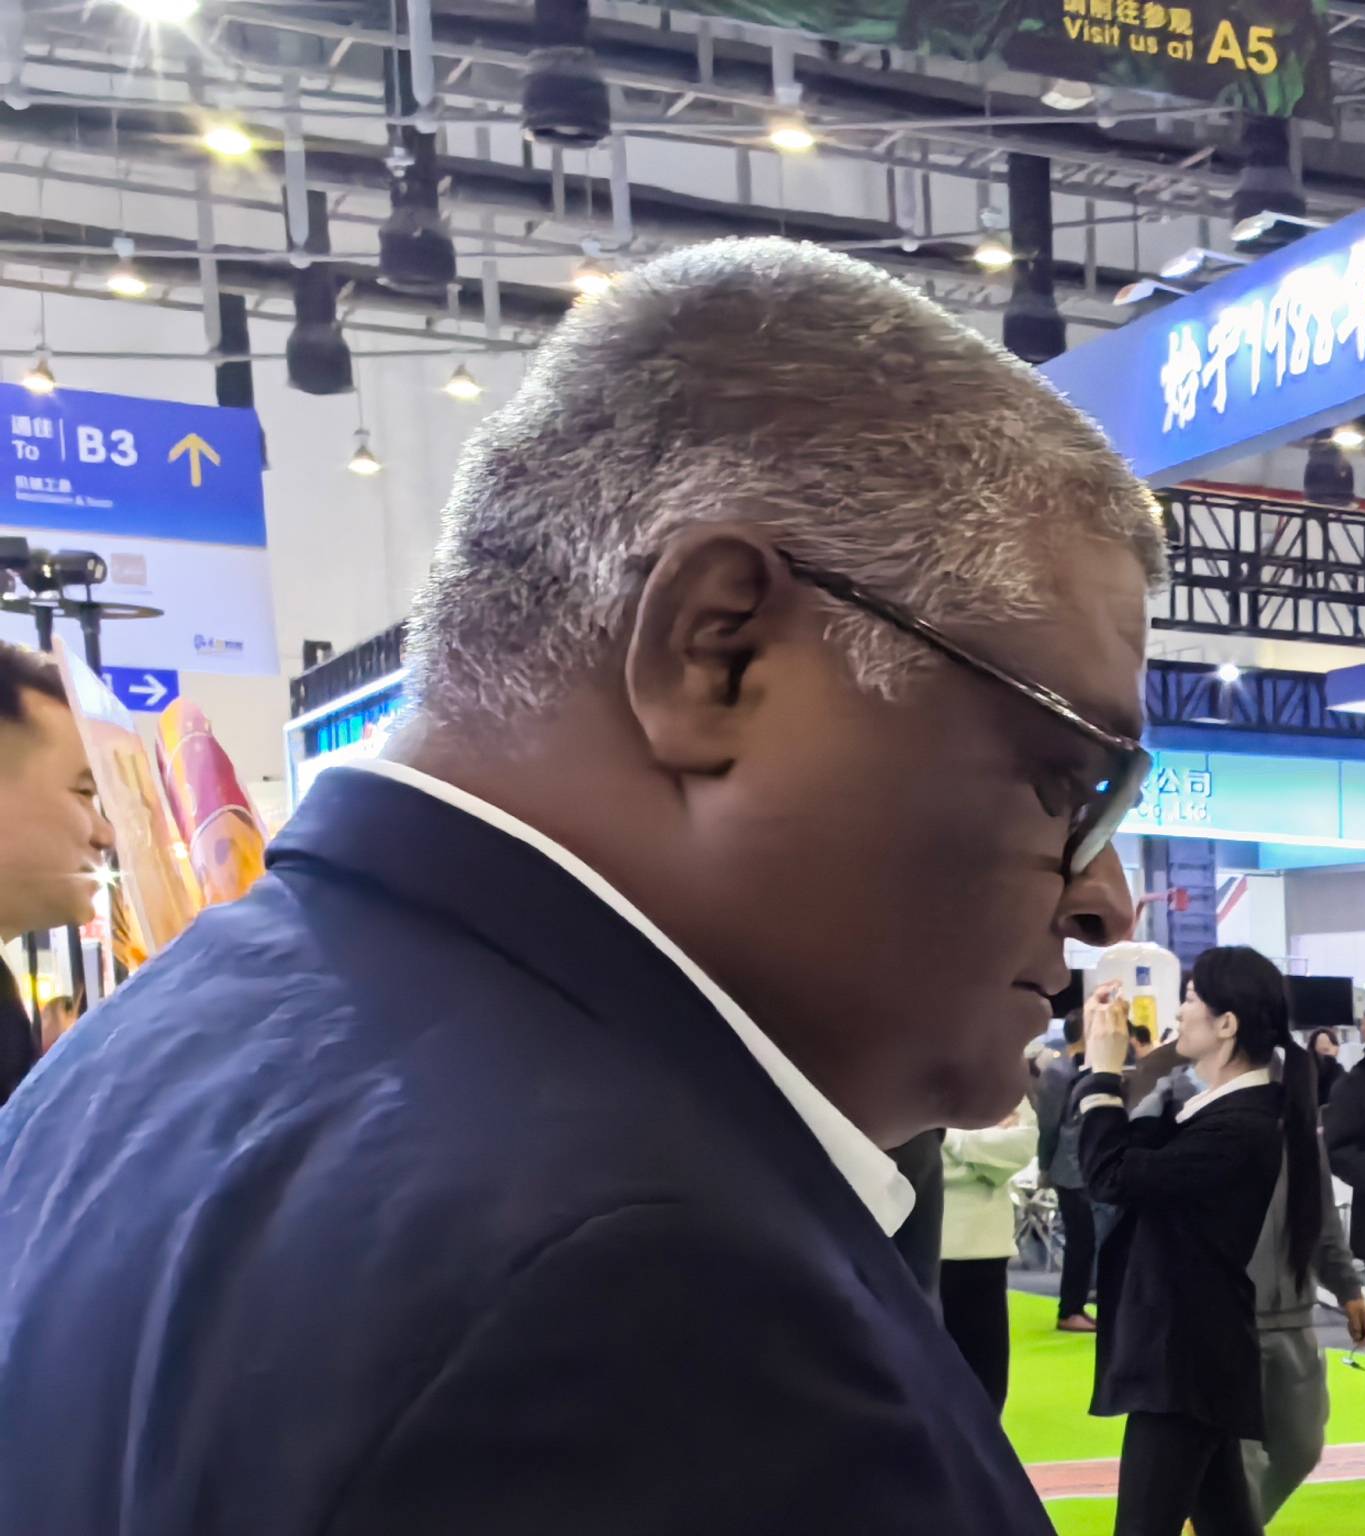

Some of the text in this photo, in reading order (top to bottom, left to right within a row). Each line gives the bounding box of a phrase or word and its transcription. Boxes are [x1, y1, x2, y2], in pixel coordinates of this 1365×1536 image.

[1063, 16, 1120, 46] Visit
[1129, 34, 1158, 54] us
[1206, 19, 1278, 75] A5
[11, 425, 138, 466] To B3
[1141, 768, 1213, 798] 公司
